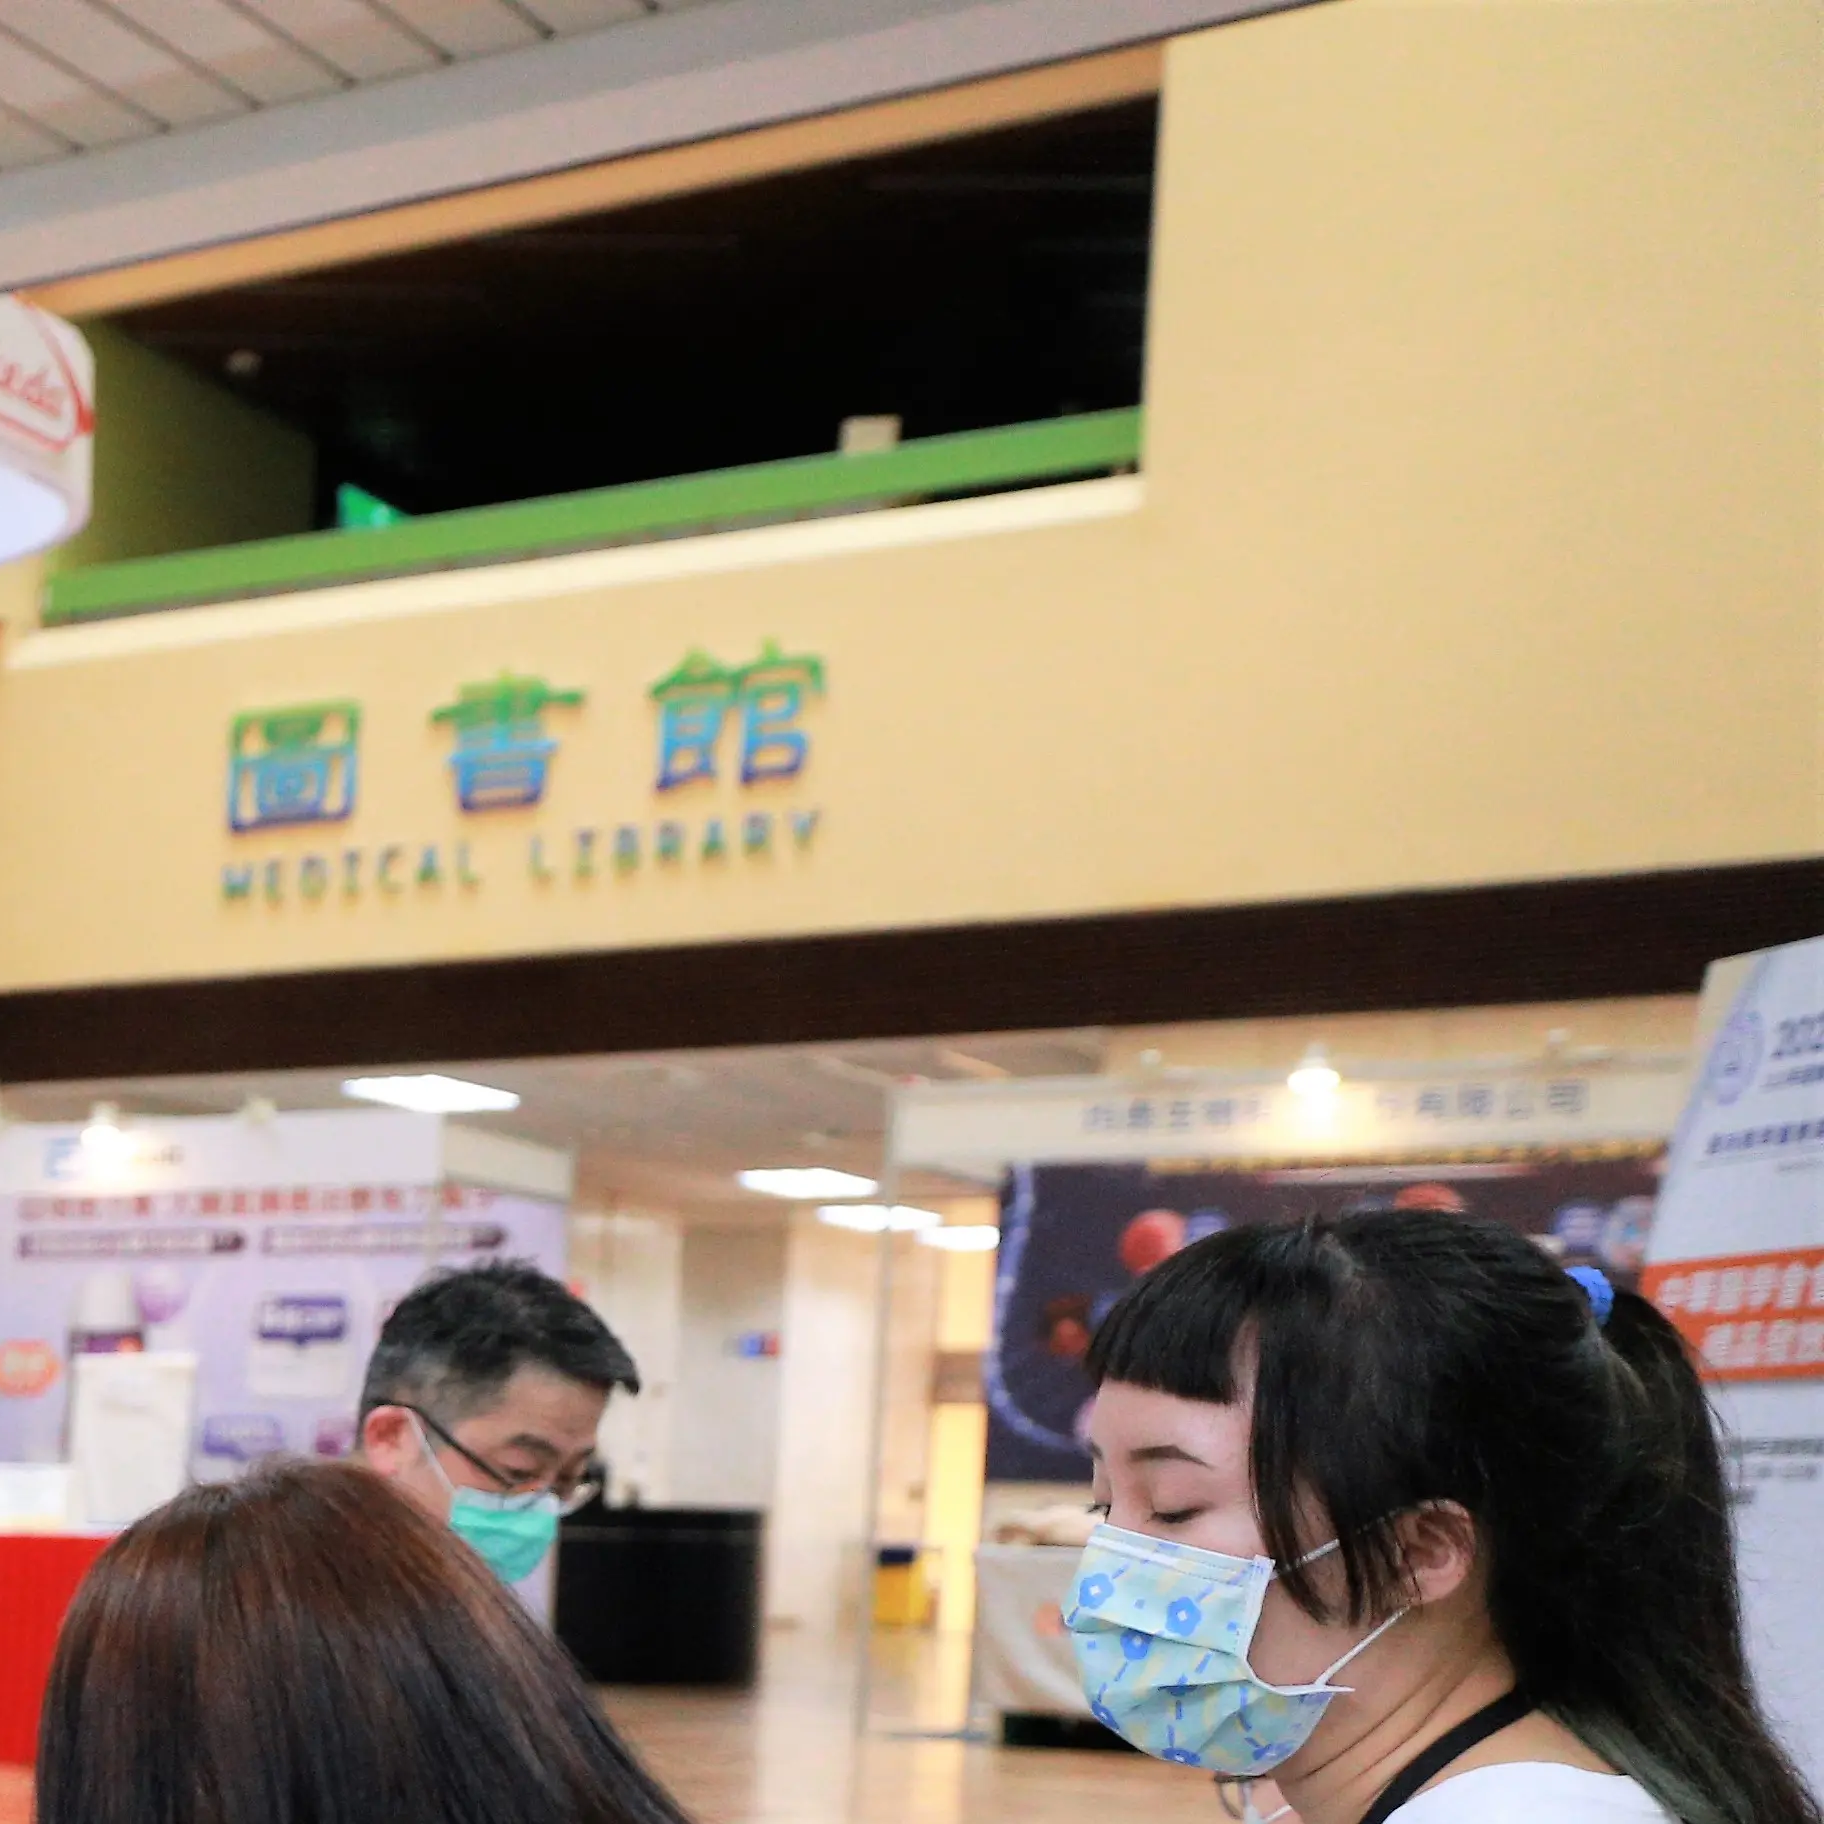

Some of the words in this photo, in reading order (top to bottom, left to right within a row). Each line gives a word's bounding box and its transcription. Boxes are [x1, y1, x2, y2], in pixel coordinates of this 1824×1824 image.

[225, 637, 826, 833] 圖書館
[222, 842, 480, 902] MEDICAL
[529, 810, 820, 886] LIBRARY
